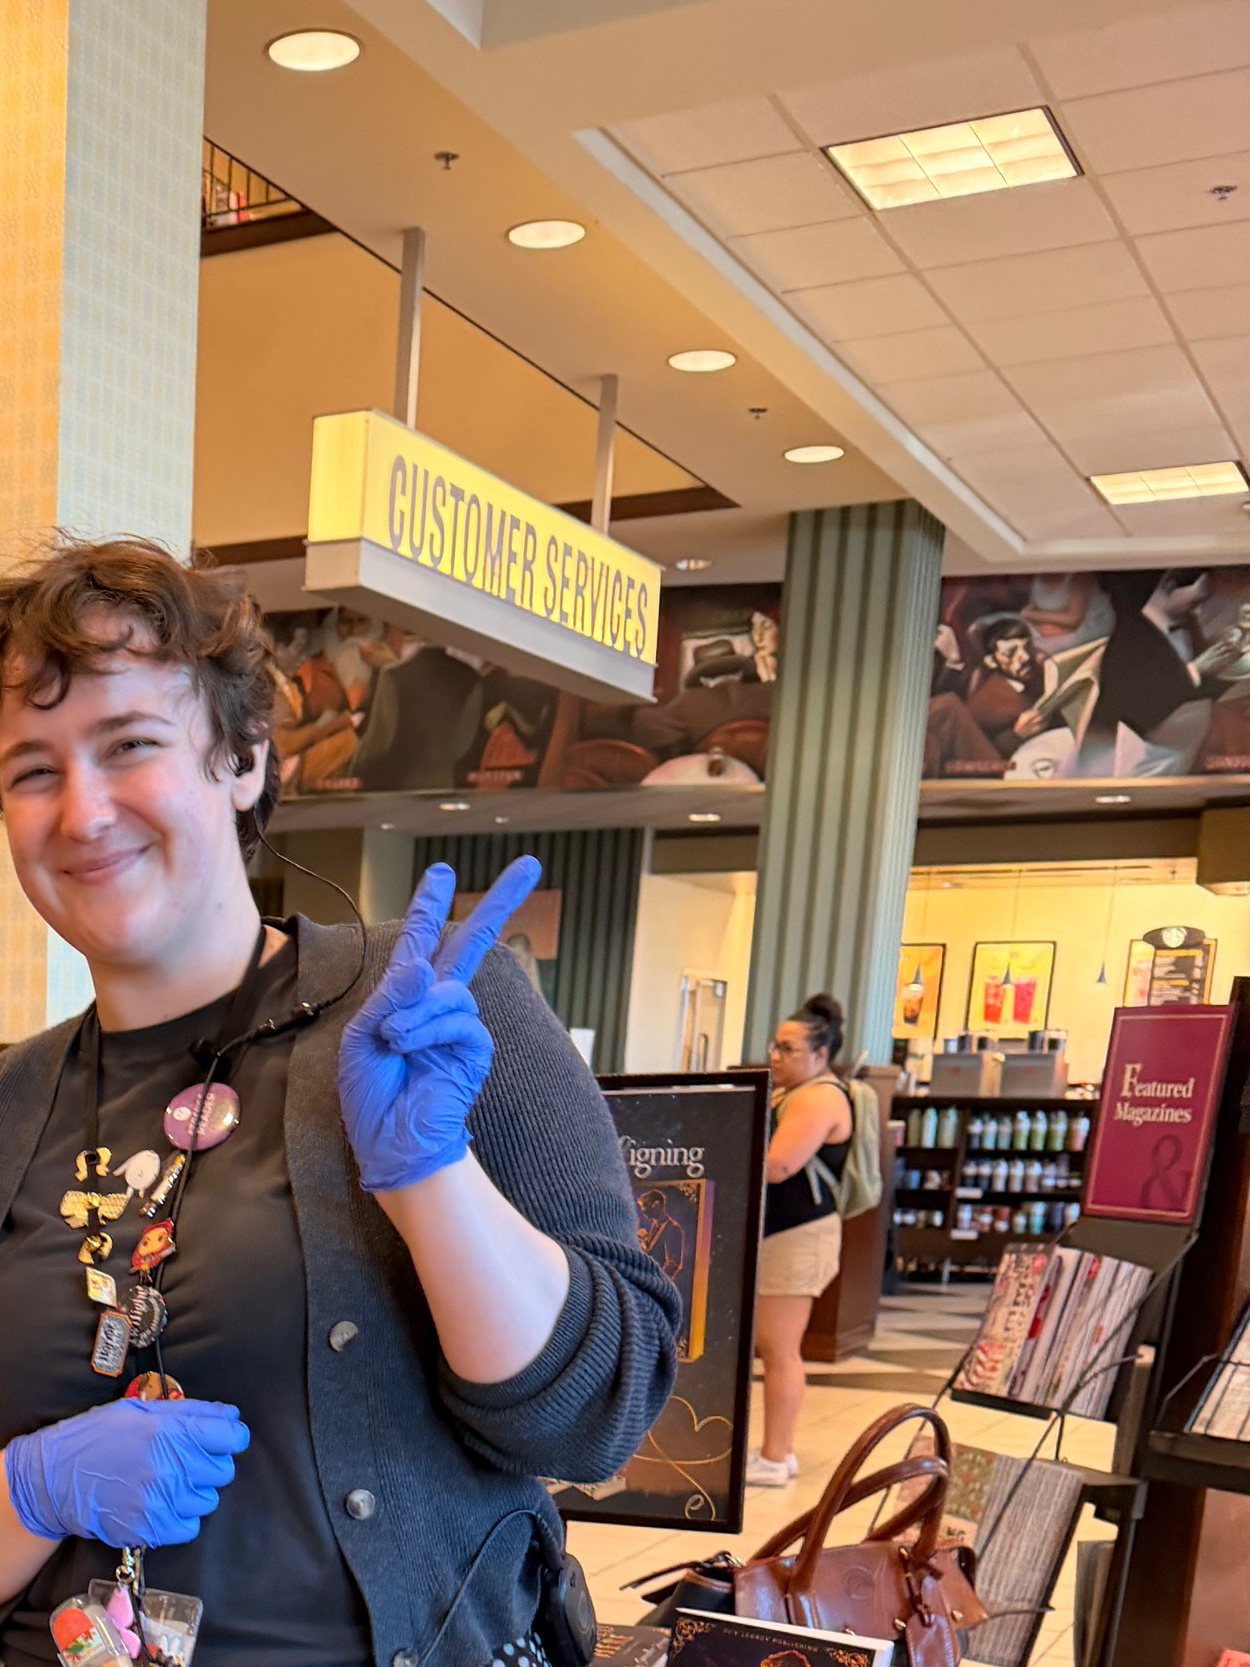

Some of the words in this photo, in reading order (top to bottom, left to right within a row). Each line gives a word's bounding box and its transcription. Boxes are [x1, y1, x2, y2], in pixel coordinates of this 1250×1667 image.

[388, 454, 538, 610] CUSTOMER
[543, 534, 648, 659] SERVICES
[1120, 1062, 1196, 1098] Featured
[1114, 1102, 1193, 1128] Magazines
